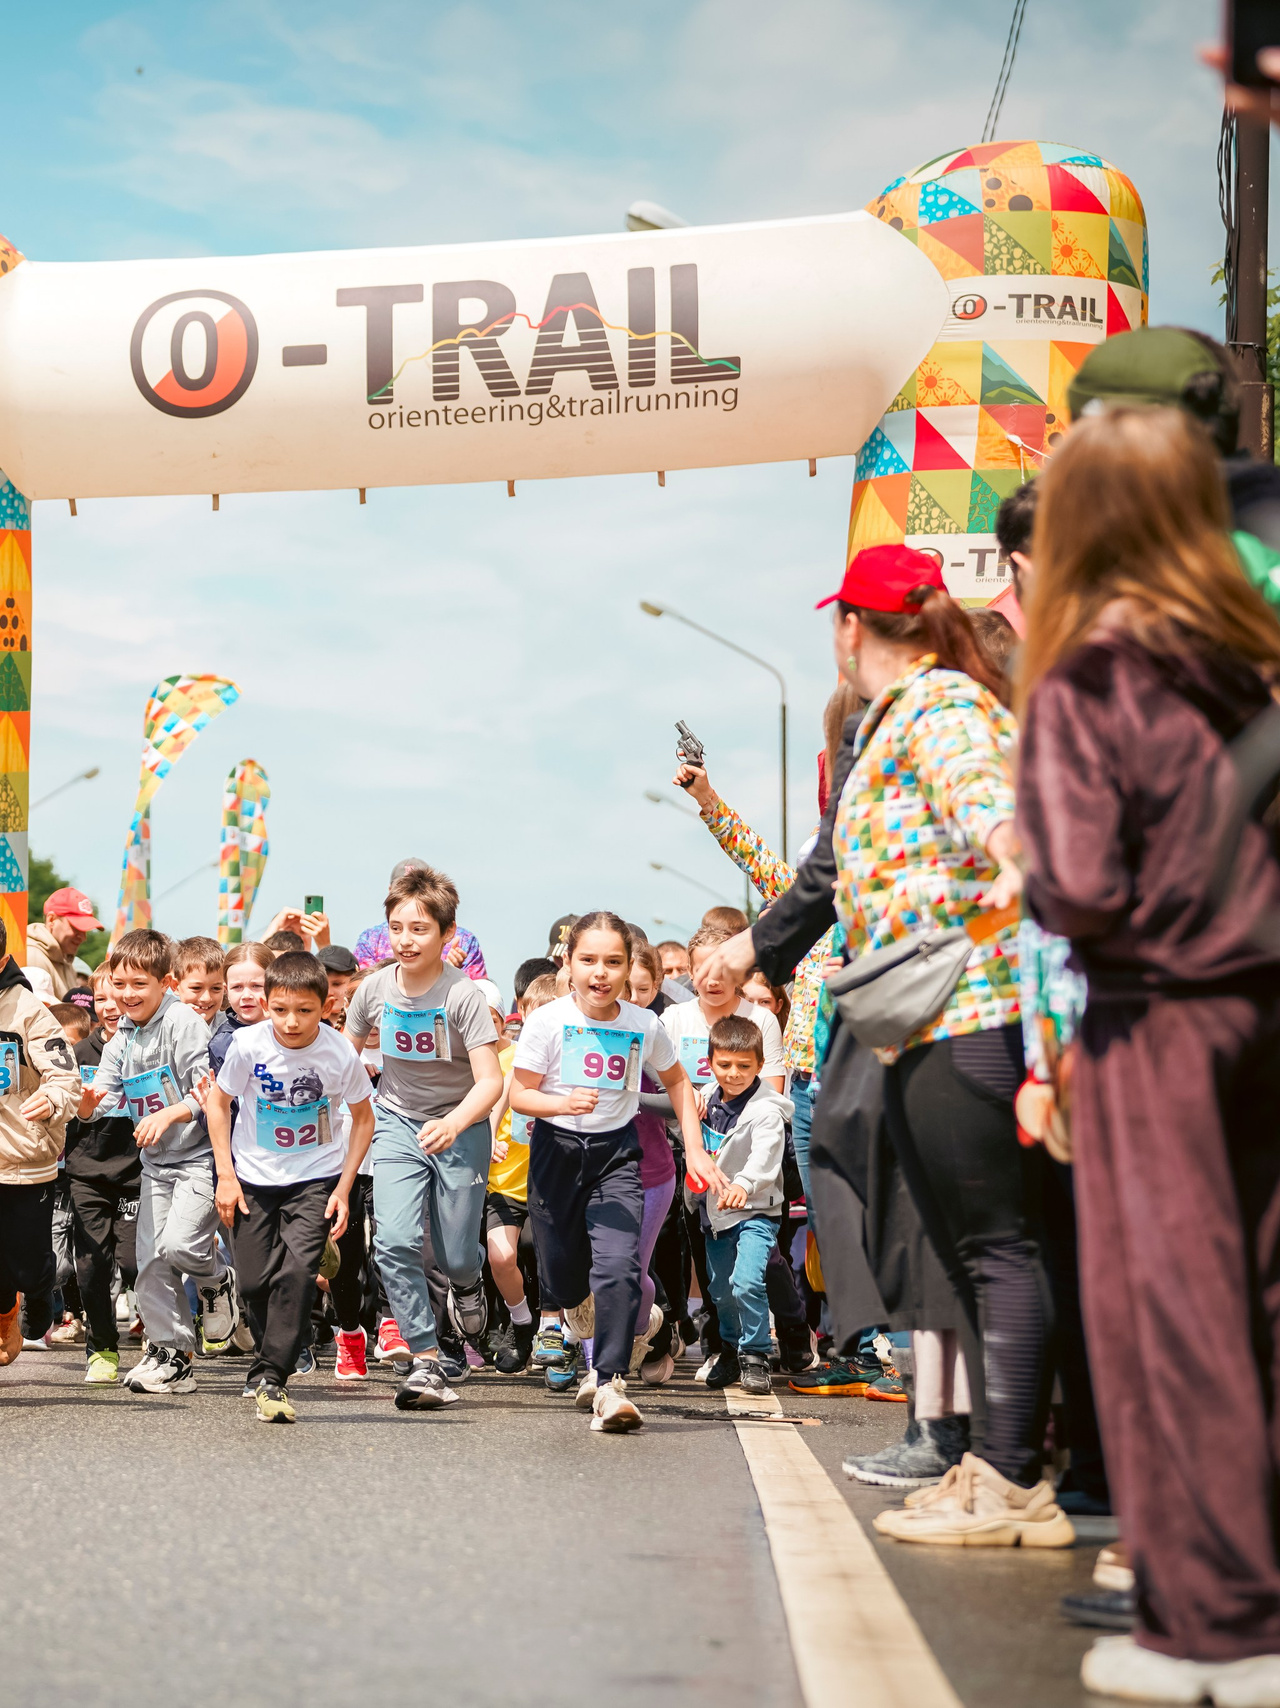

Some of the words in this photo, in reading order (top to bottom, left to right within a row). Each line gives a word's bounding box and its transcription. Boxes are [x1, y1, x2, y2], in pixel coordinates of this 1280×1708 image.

[951, 293, 1103, 324] O-TRAIL
[129, 262, 742, 420] O-TRAIL
[367, 384, 740, 430] orienteering&trailrunning
[44, 1037, 75, 1071] 3
[394, 1030, 435, 1054] 98
[583, 1052, 626, 1081] 99
[129, 1092, 166, 1117] 75
[274, 1123, 317, 1148] 92
